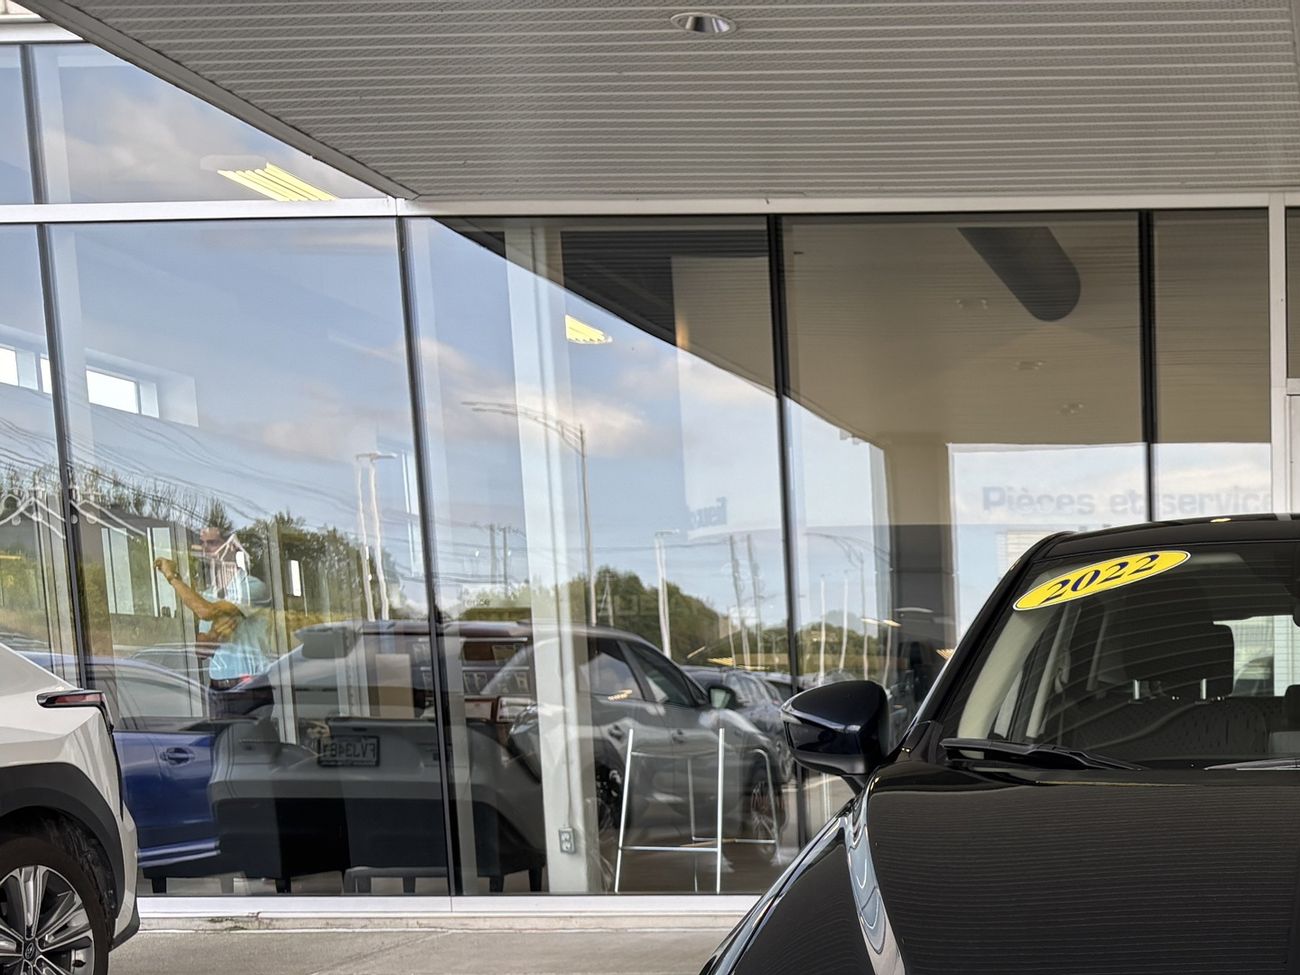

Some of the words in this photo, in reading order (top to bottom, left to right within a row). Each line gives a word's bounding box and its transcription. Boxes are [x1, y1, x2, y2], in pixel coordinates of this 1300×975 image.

[982, 485, 1096, 516] Pièces
[1110, 488, 1144, 514] et
[1041, 553, 1160, 605] 2022
